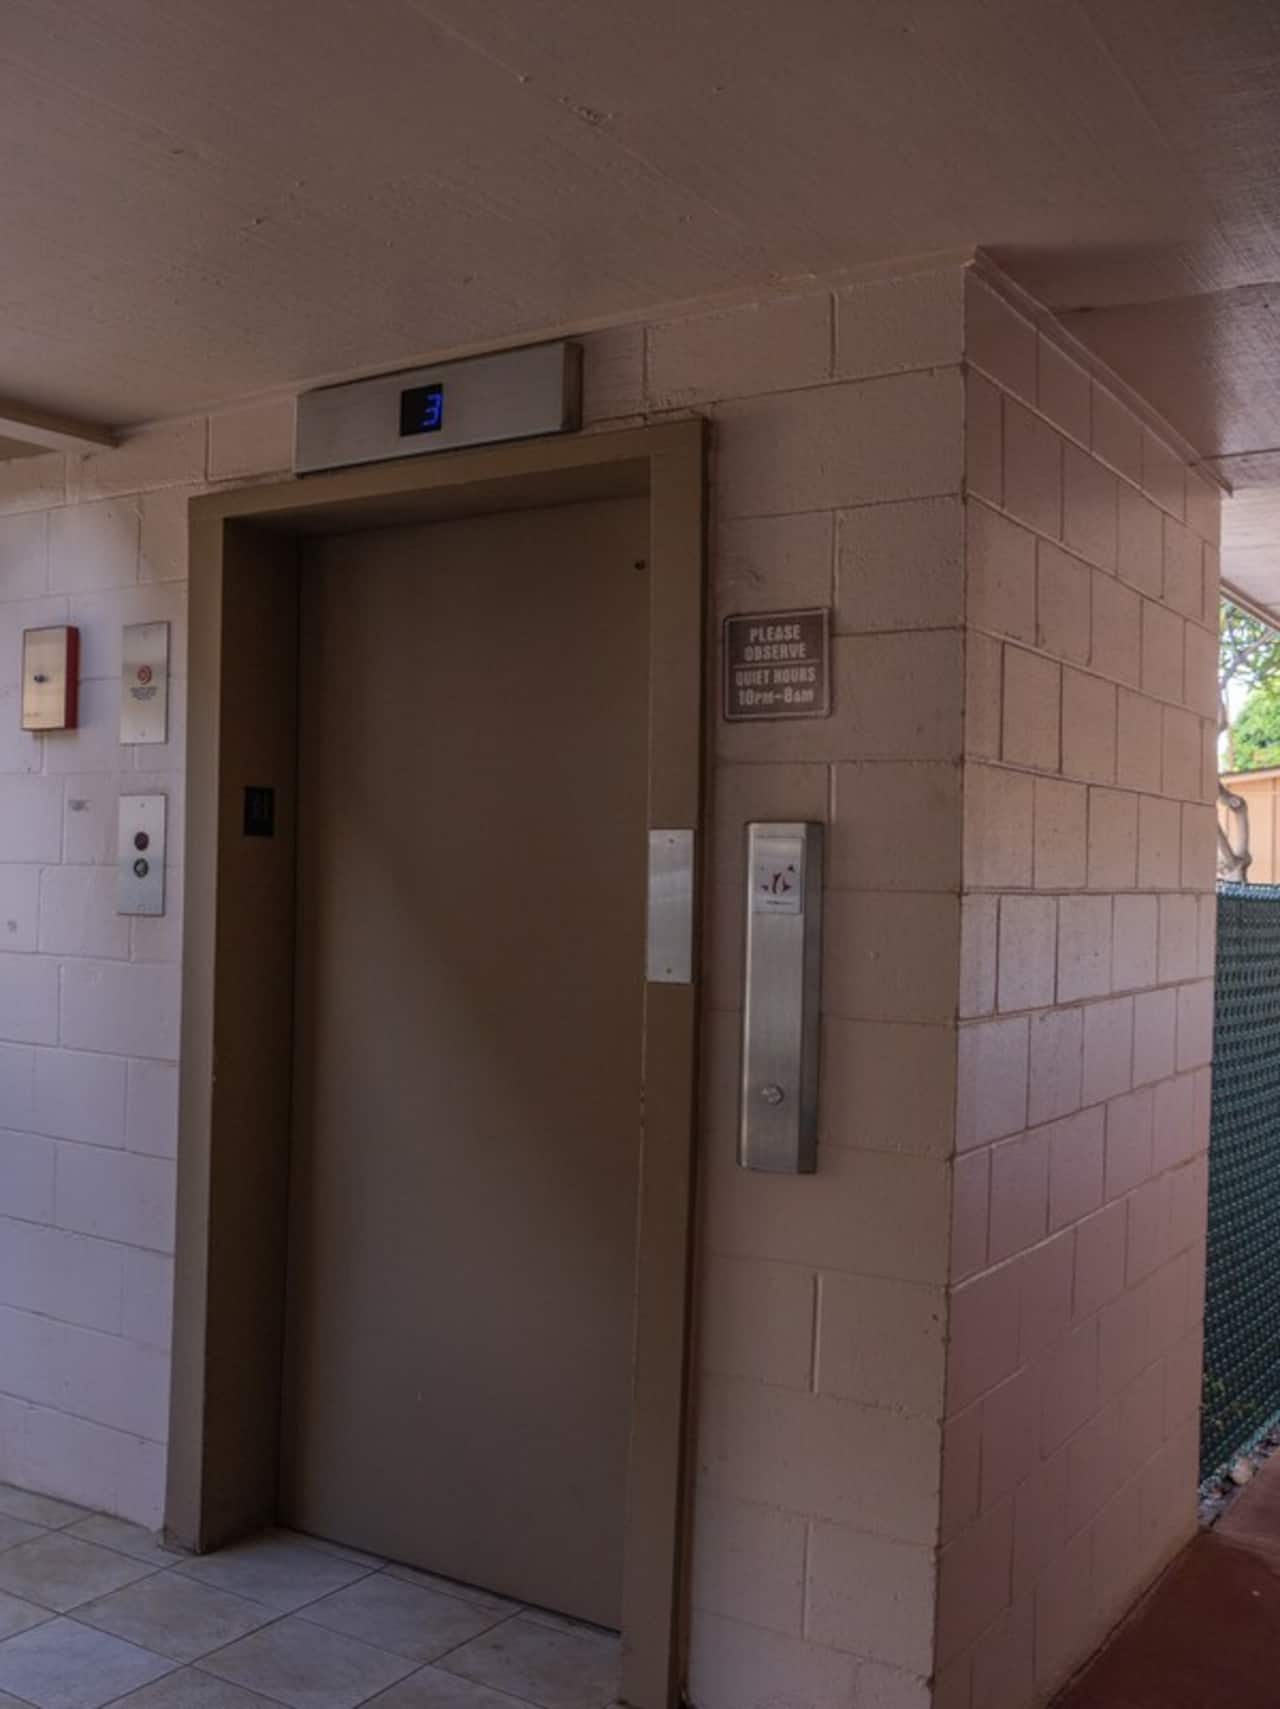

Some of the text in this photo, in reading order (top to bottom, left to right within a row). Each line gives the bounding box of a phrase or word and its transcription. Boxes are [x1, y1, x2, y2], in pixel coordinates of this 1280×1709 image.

[421, 394, 443, 426] 3
[750, 625, 801, 642] PLEASE
[744, 643, 807, 661] OBSERVE
[735, 667, 816, 686] QUIET HOURS
